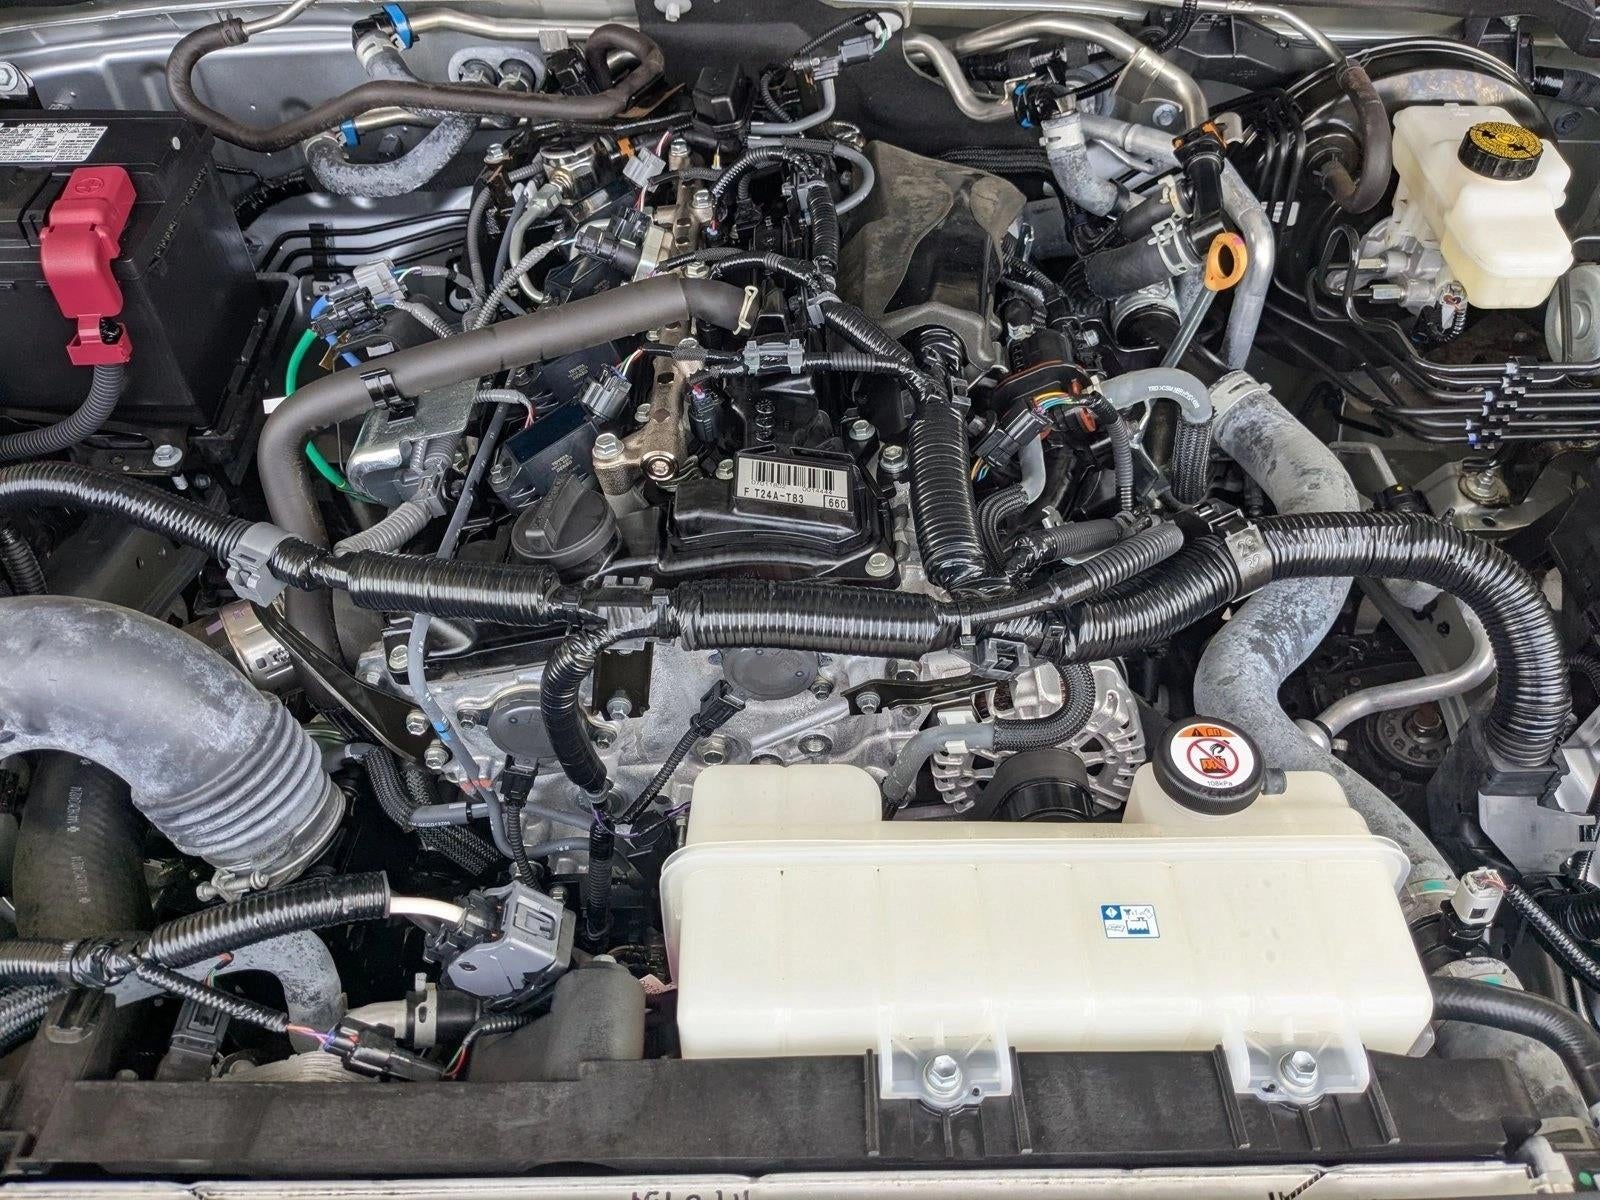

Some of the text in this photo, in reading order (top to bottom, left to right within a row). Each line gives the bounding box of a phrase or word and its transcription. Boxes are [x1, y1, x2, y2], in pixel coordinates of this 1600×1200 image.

[744, 487, 804, 504] F T24A-T83
[828, 498, 846, 509] 660
